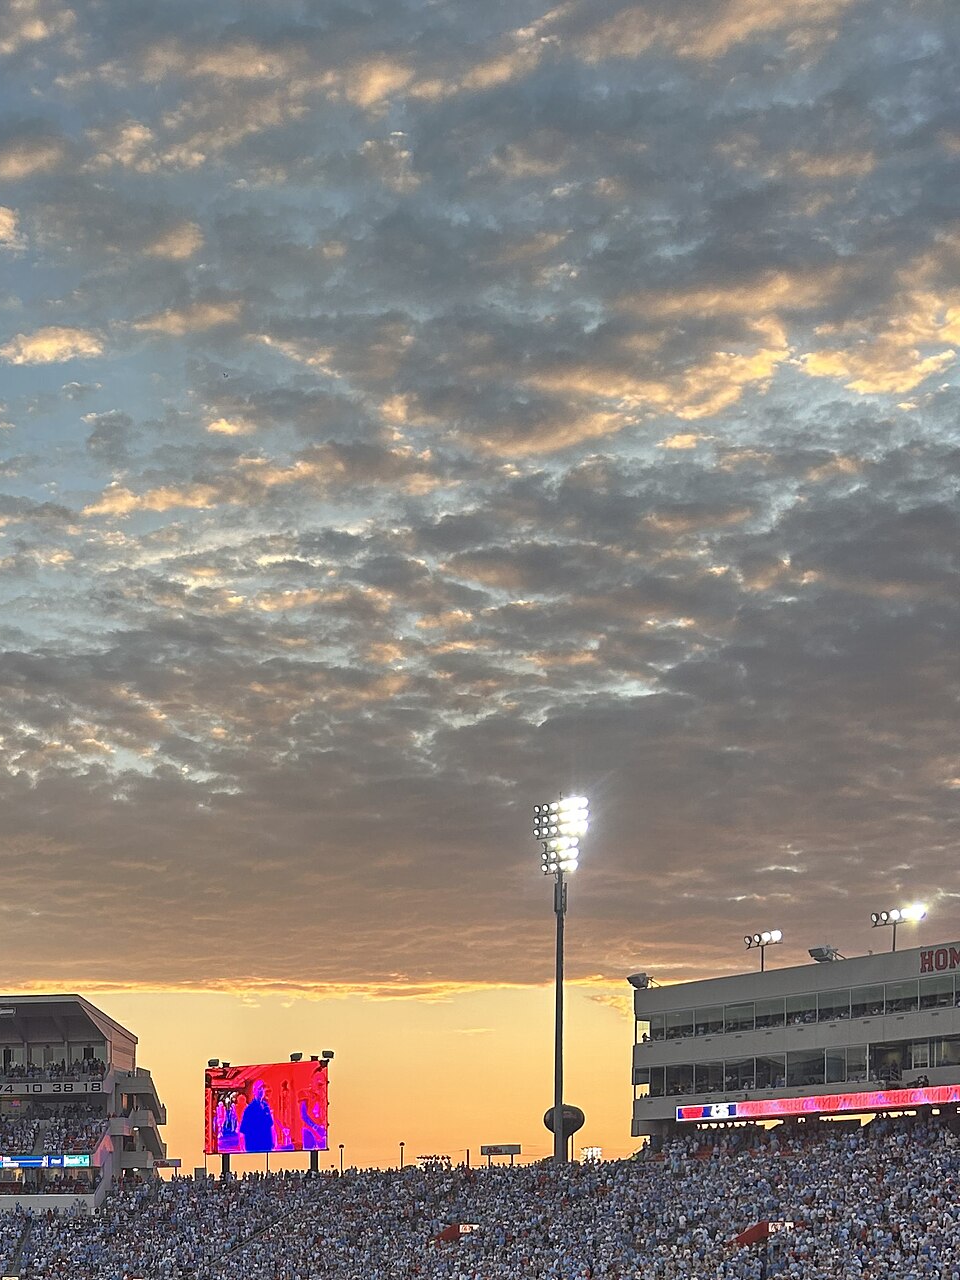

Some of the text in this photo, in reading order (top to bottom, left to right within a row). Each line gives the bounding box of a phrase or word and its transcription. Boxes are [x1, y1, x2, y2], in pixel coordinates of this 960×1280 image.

[24, 1084, 43, 1094] 10
[52, 1083, 74, 1093] 38
[83, 1082, 101, 1092] 18
